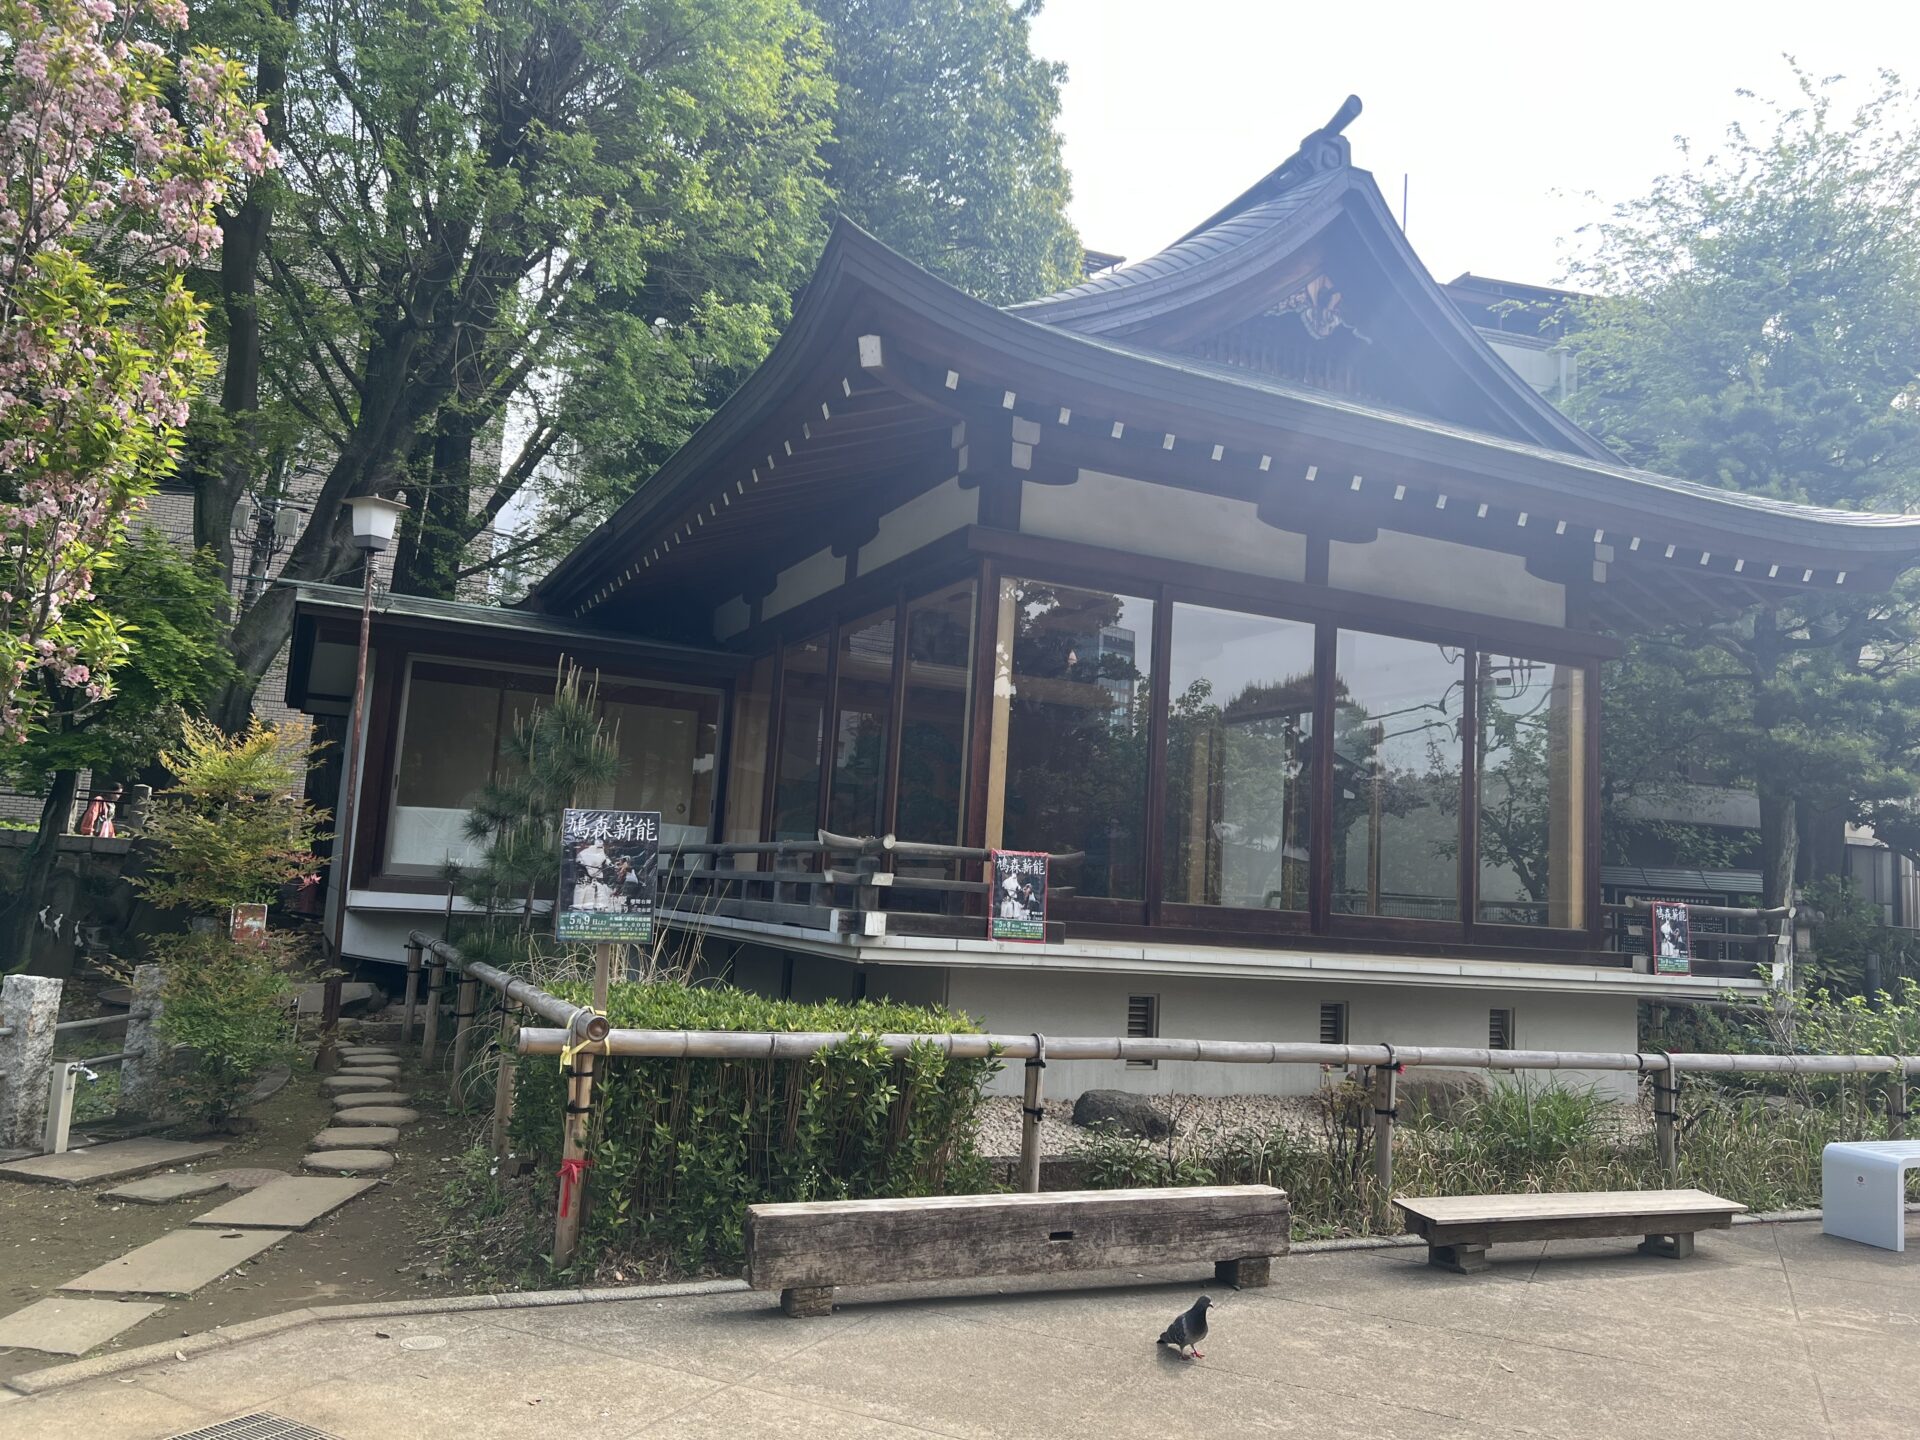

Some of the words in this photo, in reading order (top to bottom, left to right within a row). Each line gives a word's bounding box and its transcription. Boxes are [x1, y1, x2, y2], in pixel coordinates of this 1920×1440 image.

[565, 815, 658, 841] 鳩森薪能
[997, 856, 1046, 875] 鳩森薪能
